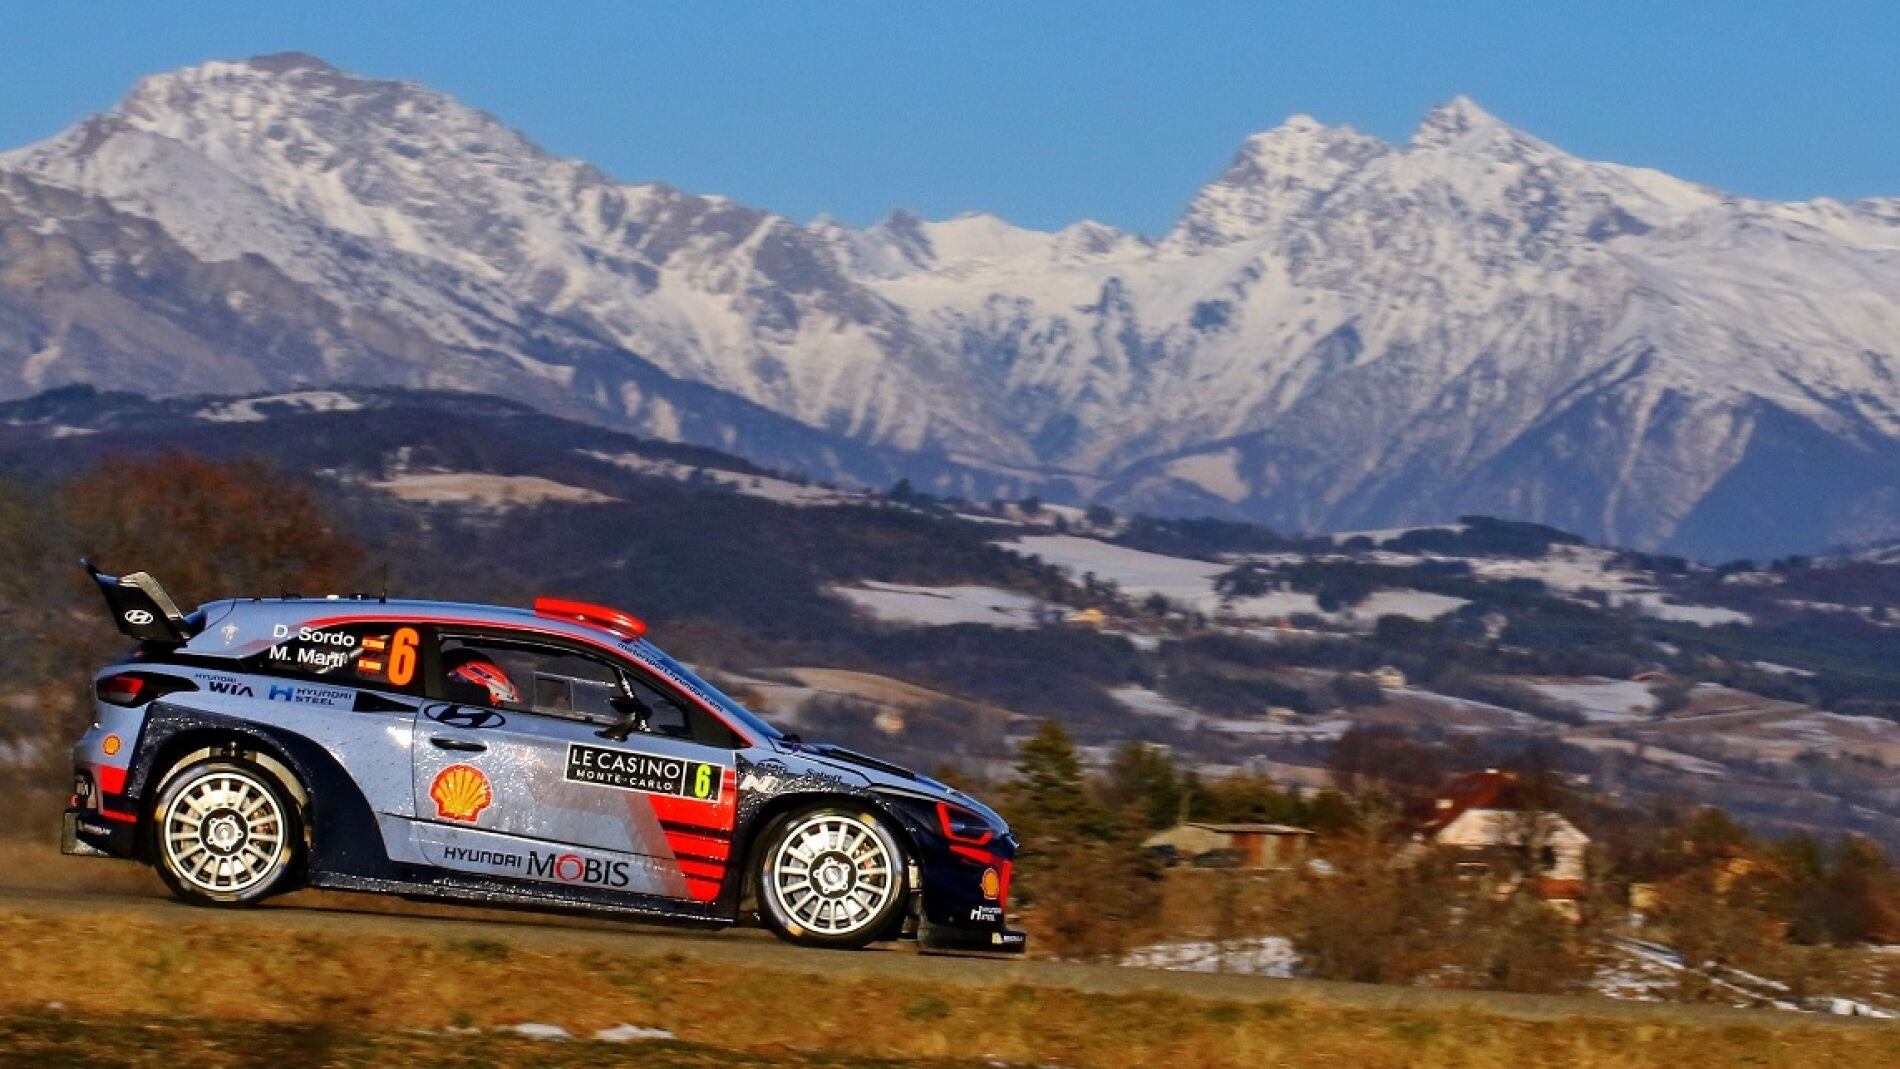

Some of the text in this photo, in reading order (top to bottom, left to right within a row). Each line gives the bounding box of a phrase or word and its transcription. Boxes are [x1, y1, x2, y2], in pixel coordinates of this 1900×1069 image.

[273, 624, 355, 647] D. Sordo
[269, 644, 292, 661] M.
[387, 627, 420, 686] 6
[295, 697, 335, 705] STEEL
[296, 688, 352, 699] HYUNDAI
[571, 749, 681, 779] LE CASINO
[694, 763, 711, 798] 6
[443, 846, 522, 868] HYUNDAI
[526, 850, 630, 887] MOBIS
